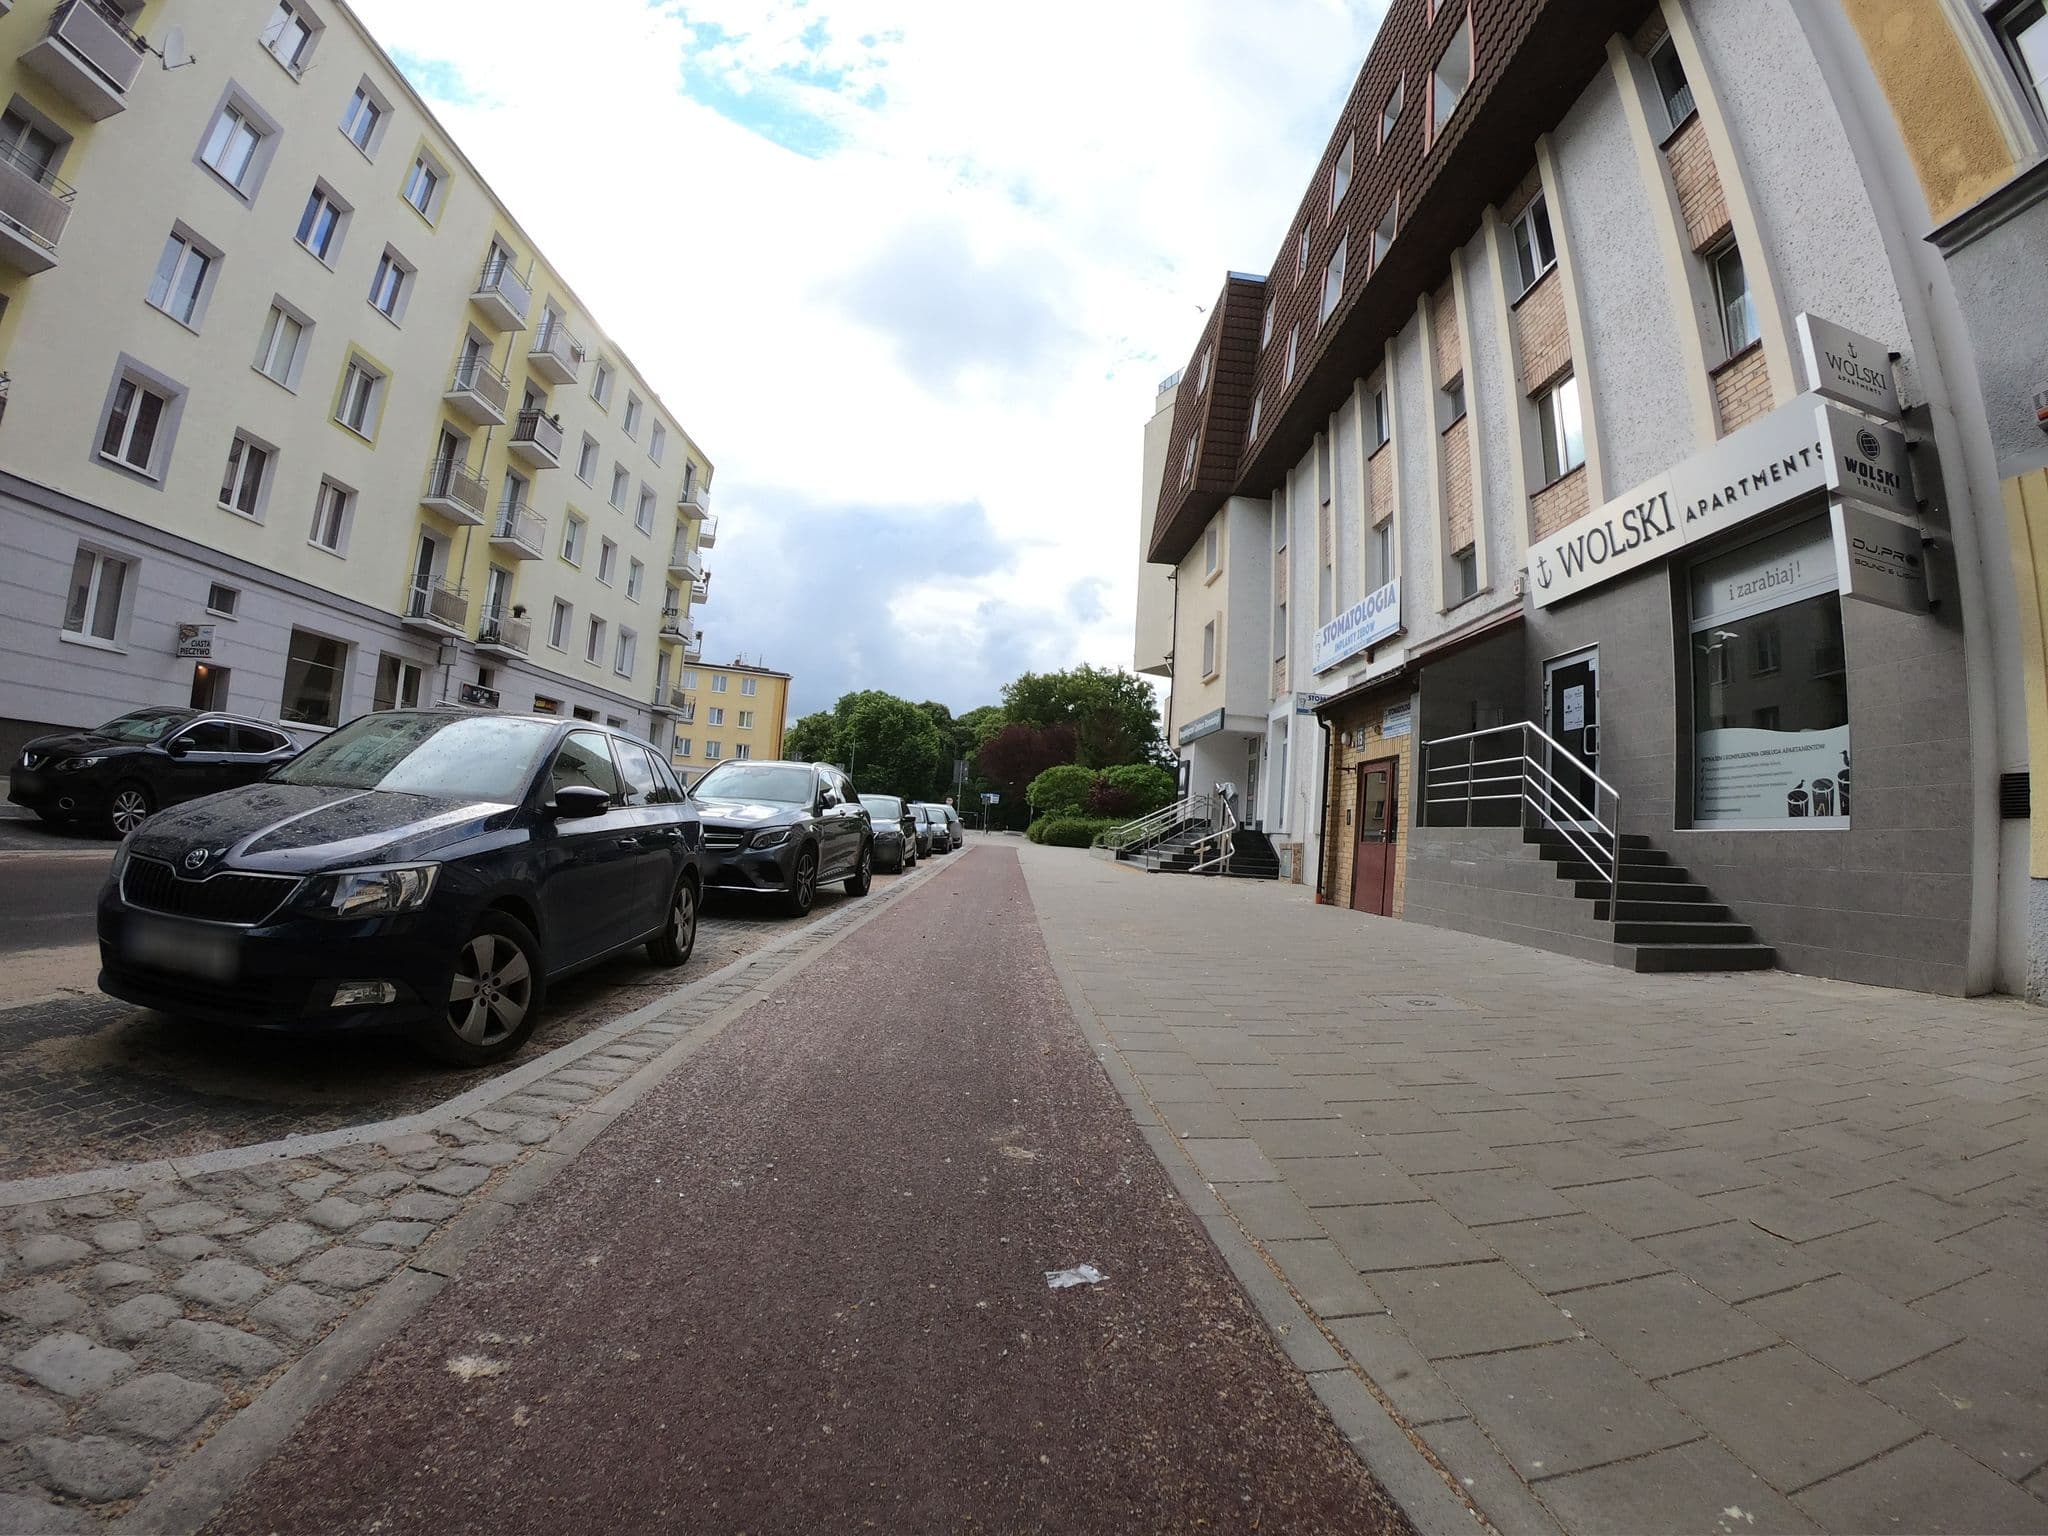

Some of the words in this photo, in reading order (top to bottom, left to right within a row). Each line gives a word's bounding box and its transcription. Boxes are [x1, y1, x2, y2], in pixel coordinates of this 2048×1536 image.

[1825, 352, 1888, 390] WOLSKI
[1844, 456, 1901, 489] WOLSKI
[1857, 477, 1894, 496] TRAVEL
[1557, 491, 1676, 578] WOLSKI
[1686, 441, 1823, 524] APARTMENTS
[1729, 584, 1735, 600] i
[1323, 583, 1396, 647] STOMATOLOGIA
